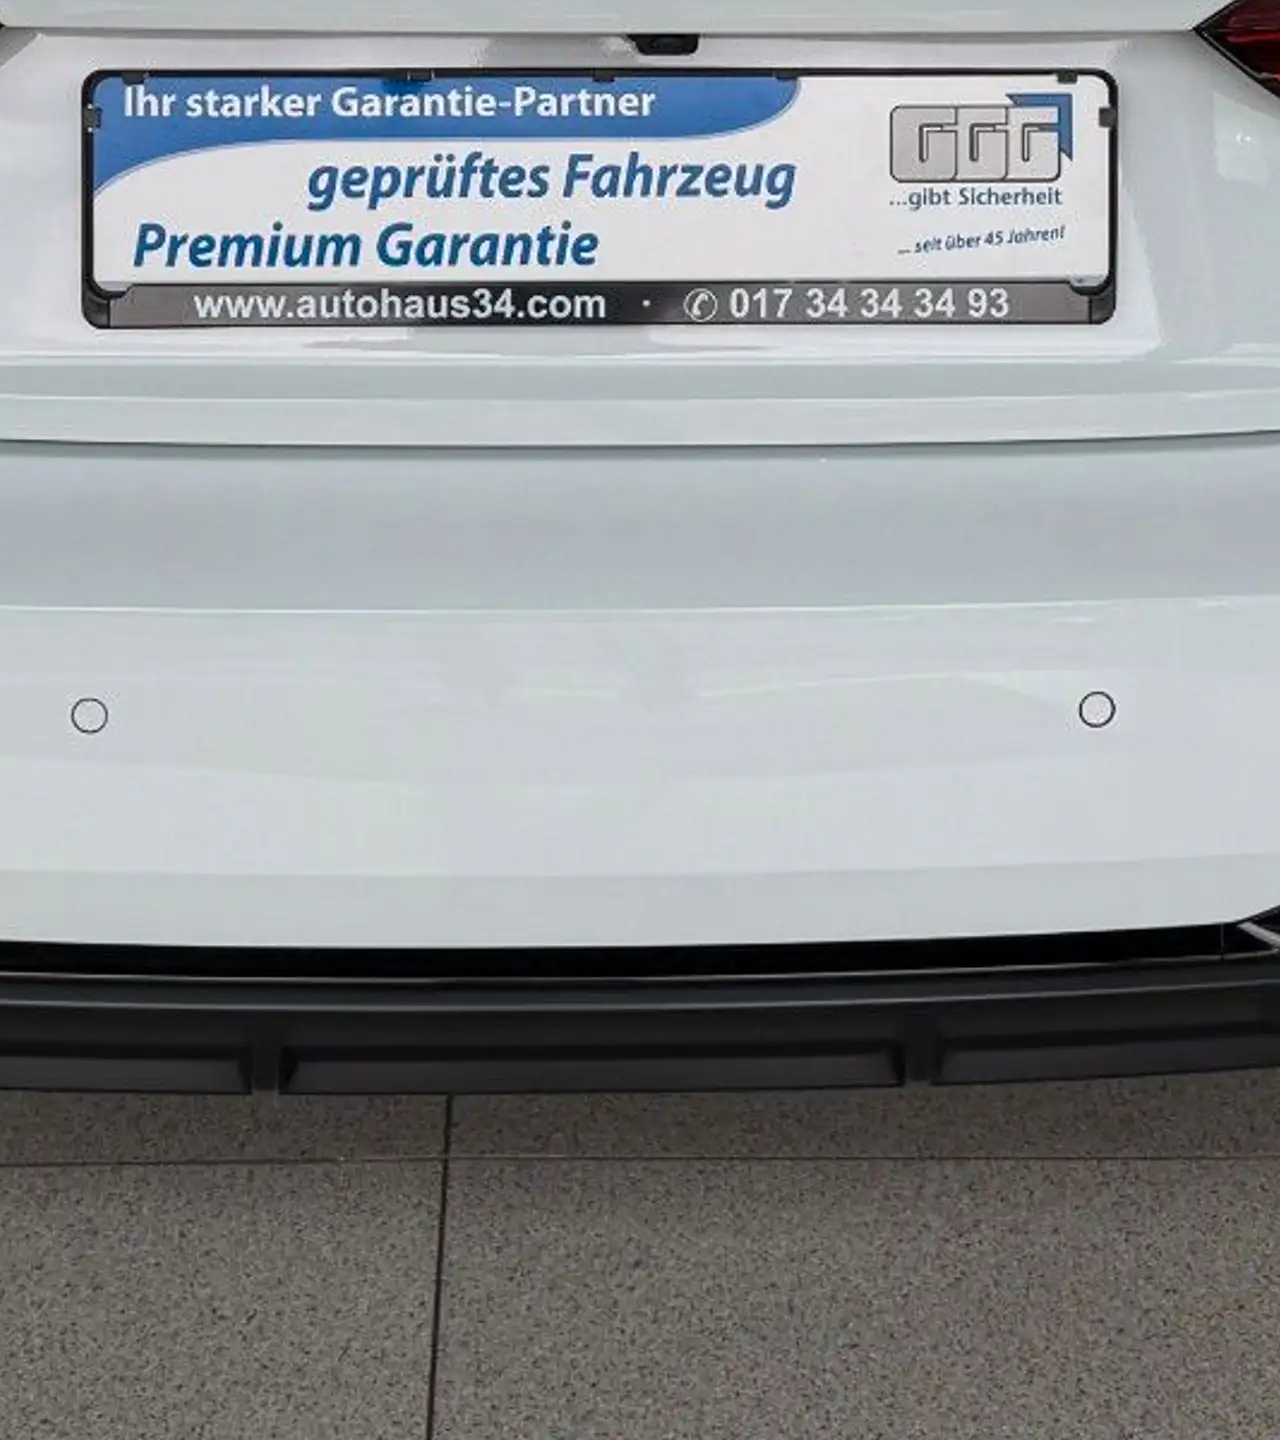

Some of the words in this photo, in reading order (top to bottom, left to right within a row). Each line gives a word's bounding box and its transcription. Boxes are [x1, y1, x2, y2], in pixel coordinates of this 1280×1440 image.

[123, 84, 176, 117] Ihr
[185, 85, 322, 118] starker
[331, 85, 657, 118] Garantie-Partner
[307, 151, 550, 211] geprüftes
[562, 151, 797, 210] Fahrzeug
[958, 187, 1063, 206] Sicherheit
[133, 221, 363, 268] Premium
[376, 220, 600, 268] Garantie
[984, 230, 1004, 246] 45
[193, 287, 607, 319] www.autohaus34.com
[729, 287, 793, 319] 017
[805, 287, 849, 319] 34
[859, 287, 903, 319] 34
[914, 287, 957, 319] 34
[967, 287, 1010, 319] 93
